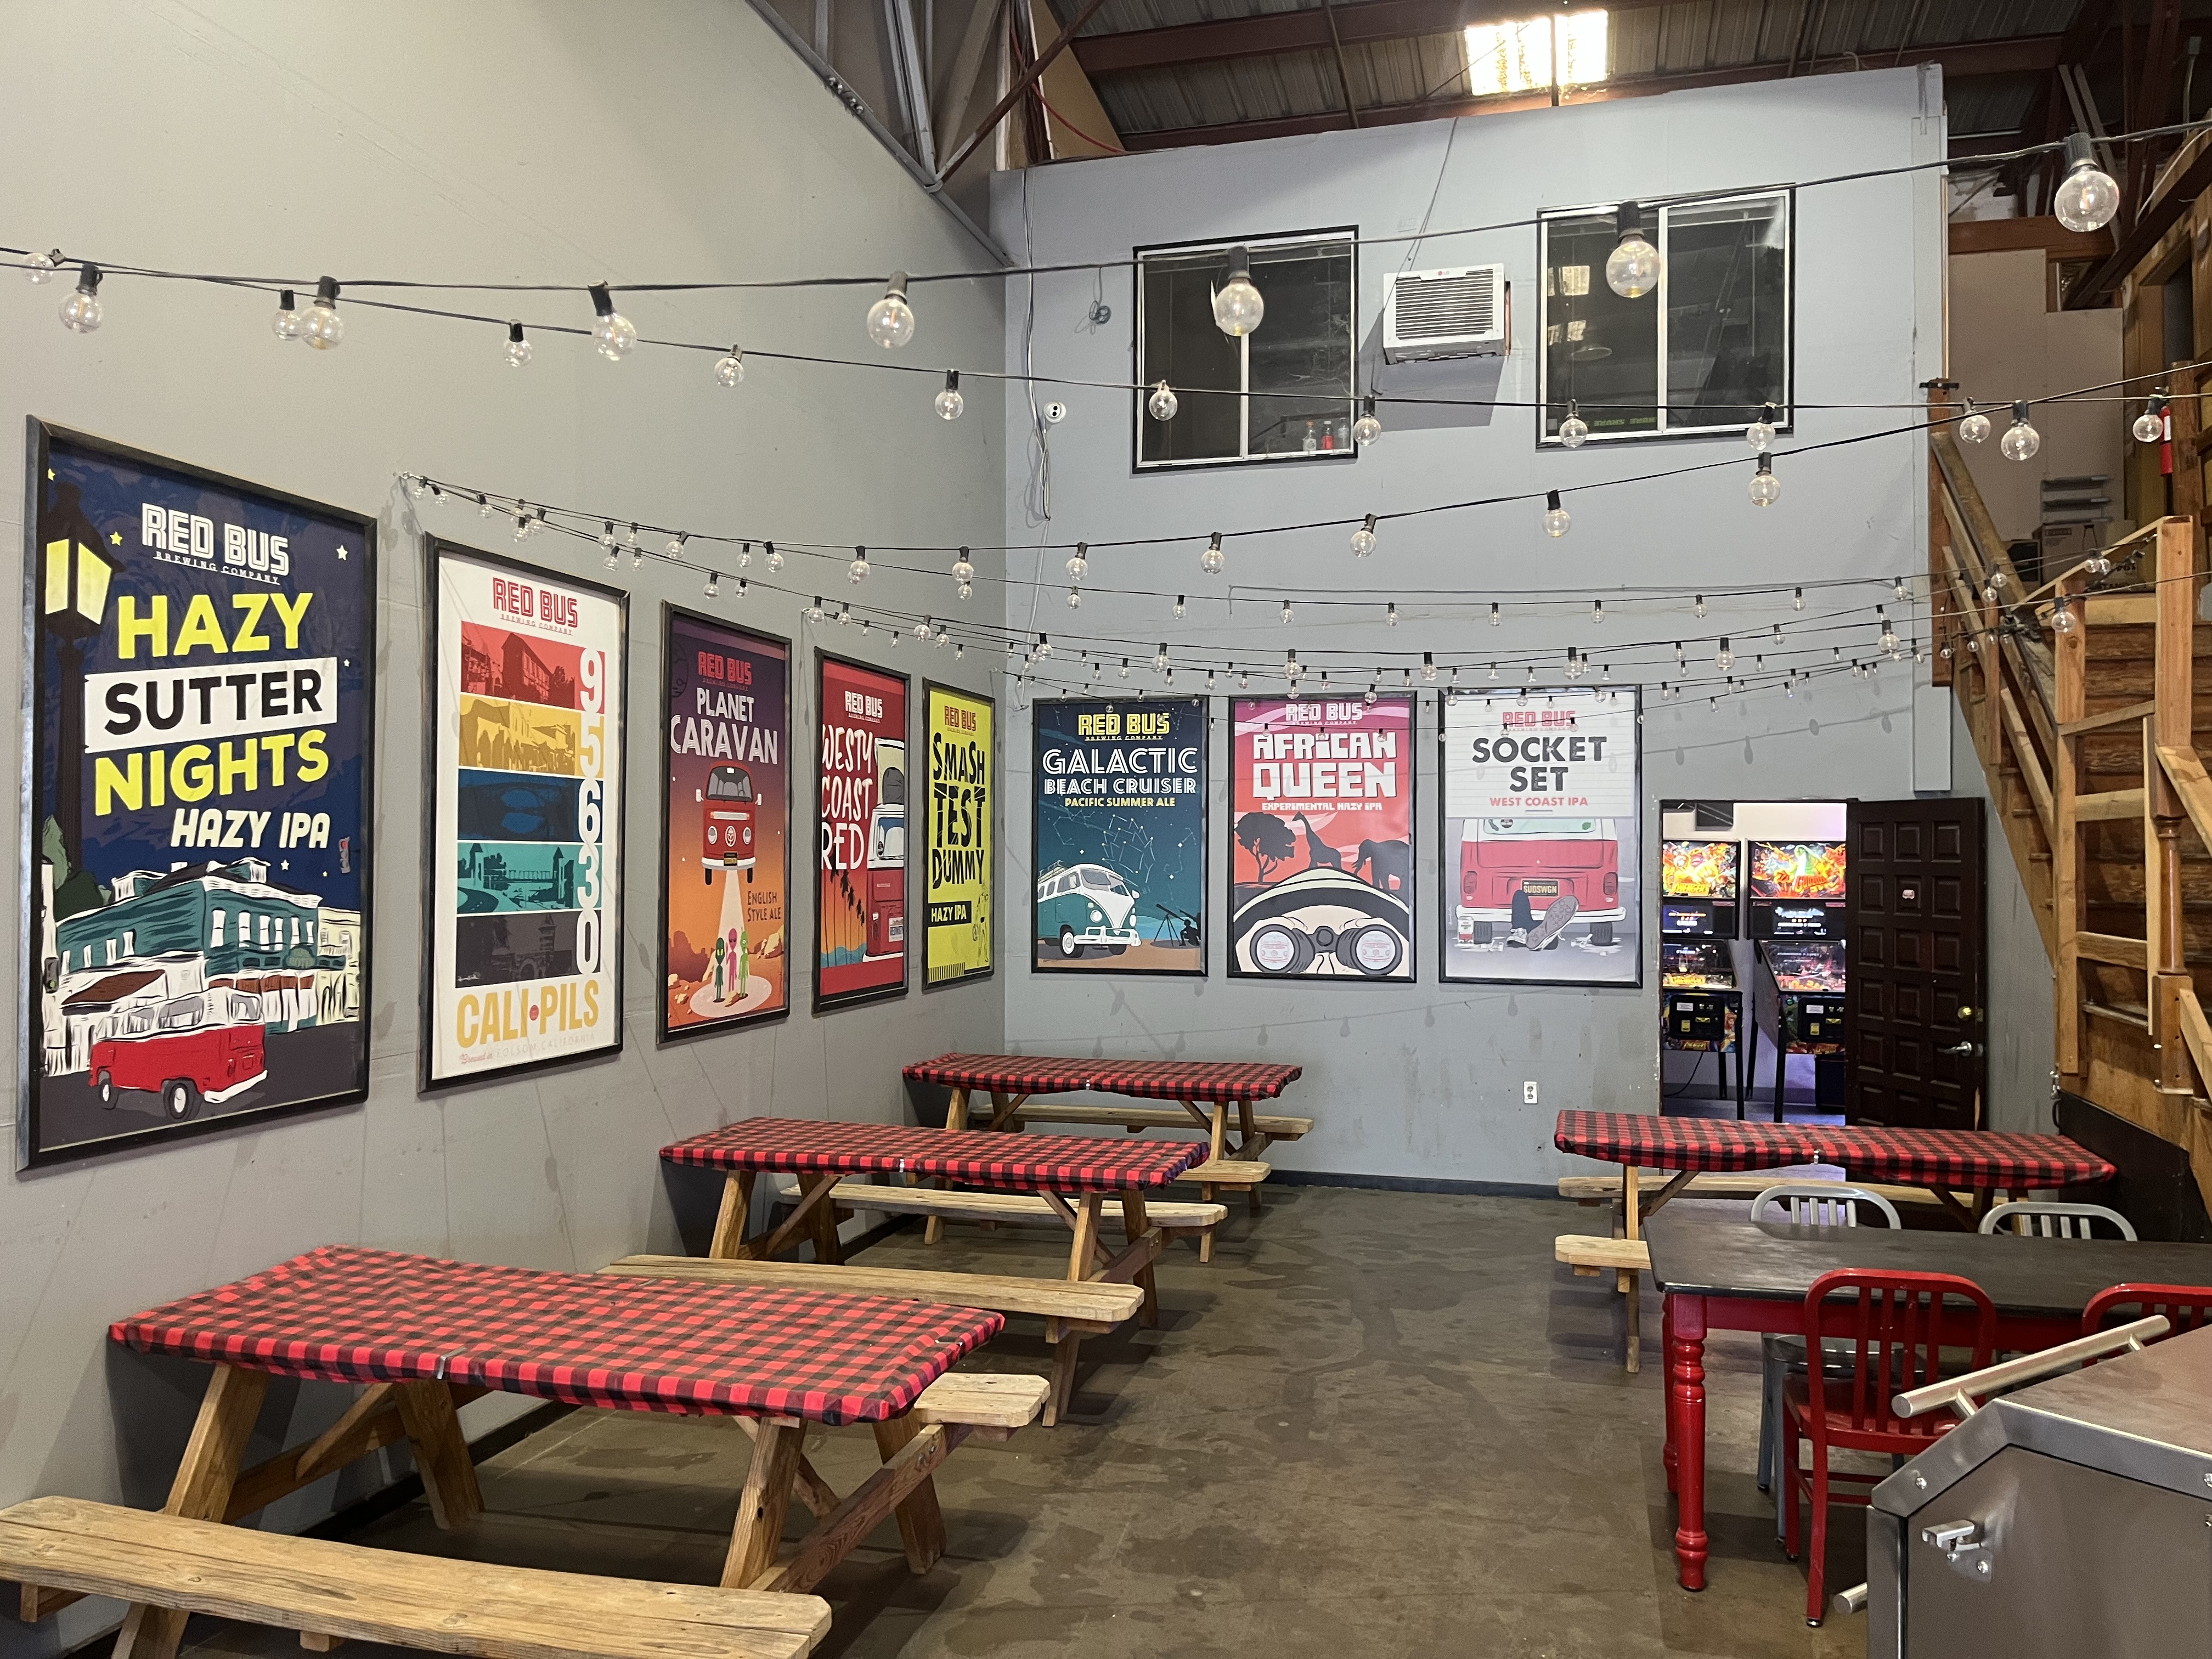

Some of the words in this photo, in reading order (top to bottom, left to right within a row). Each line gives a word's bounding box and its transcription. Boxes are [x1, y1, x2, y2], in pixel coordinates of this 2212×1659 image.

[142, 503, 214, 559] RED
[224, 523, 289, 576] BUS
[154, 551, 218, 571] BREWING
[221, 566, 280, 585] COMPANY
[493, 577, 533, 618] RED
[540, 590, 578, 628] BUS
[118, 592, 313, 659] HAZY
[539, 623, 573, 635] COMPANY
[698, 651, 724, 679] RED
[727, 658, 752, 685] BUS
[104, 669, 323, 735] SUTTER
[697, 687, 754, 722] PLANET
[845, 691, 864, 714] RED
[865, 696, 883, 718] BUS
[1286, 703, 1321, 721] RED
[1327, 703, 1363, 720] BUS
[944, 706, 959, 727] RED
[961, 709, 976, 731] BUS
[1078, 714, 1120, 736] RED
[1126, 713, 1170, 735] BUS
[1503, 712, 1536, 727] RED
[671, 714, 777, 764] CARAVAN
[822, 724, 873, 774] WESTY
[1253, 732, 1397, 759] AFRICAN
[1472, 736, 1607, 763] SOCKET
[94, 730, 329, 816] NIGHTS
[933, 732, 985, 785] SMASH
[1042, 747, 1198, 775] GALACTIC
[1044, 778, 1107, 795] BEACH
[1113, 777, 1197, 794] CRUISER
[1253, 762, 1396, 800] QUEEN
[1509, 766, 1568, 792] SET
[821, 775, 873, 821] COAST
[1065, 798, 1104, 807] PACIFIC
[1107, 797, 1154, 807] SUMMER
[1156, 797, 1175, 806] ALE
[1262, 802, 1335, 810] EXPERIMENTAL
[1337, 802, 1362, 810] HAZY
[1365, 802, 1383, 810] IPA
[1489, 797, 1522, 806] WEST
[1525, 797, 1564, 806] COAST
[1568, 797, 1588, 806] IPA
[171, 809, 272, 848] HAZY
[279, 812, 331, 848] IPA
[934, 782, 985, 848] TEST
[821, 822, 865, 870] RED
[933, 848, 984, 889] DUMMY
[747, 890, 777, 905] ENGLISH
[1523, 885, 1557, 894] SUDSWGN
[747, 907, 768, 922] STYLE
[770, 907, 781, 920] ALE
[932, 906, 953, 922] HAZY
[955, 905, 967, 921] IPA
[456, 988, 529, 1048] CALI
[539, 980, 600, 1035] PILS
